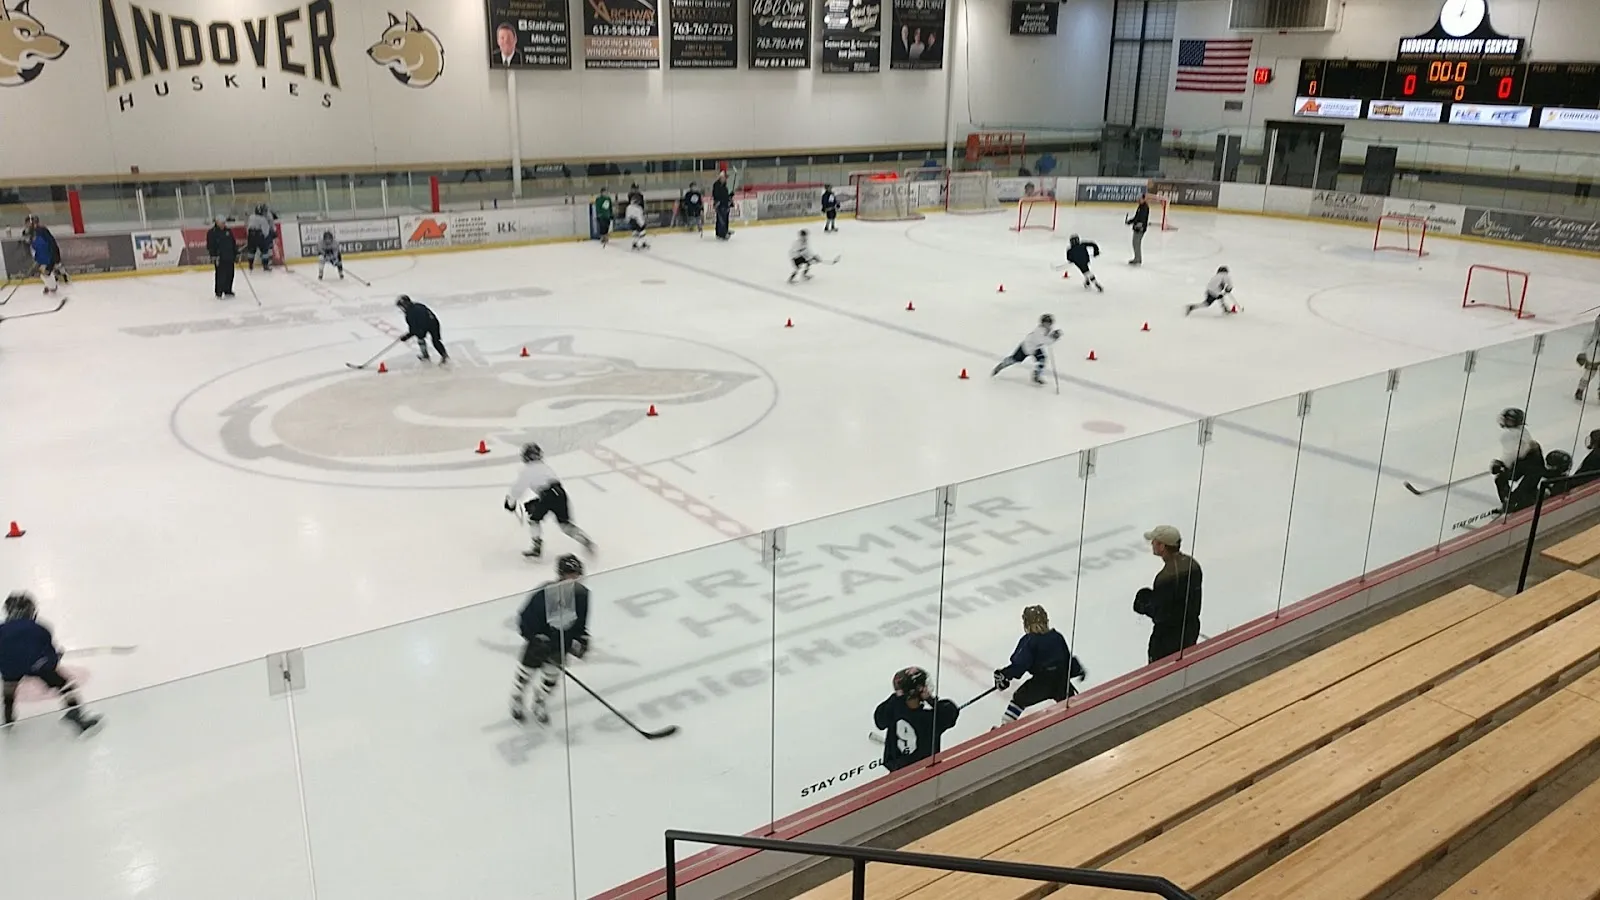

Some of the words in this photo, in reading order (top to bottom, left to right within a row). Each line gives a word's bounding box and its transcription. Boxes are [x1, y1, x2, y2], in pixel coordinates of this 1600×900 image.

[102, 0, 341, 91] ANDOVER
[531, 33, 550, 44] Mike
[591, 38, 623, 47] ROOFING
[629, 38, 652, 47] SIDING
[1400, 39, 1436, 53] ANDOVER
[1436, 39, 1485, 54] COMMUNITY
[1485, 39, 1519, 54] CENTER
[586, 48, 622, 57] WINDOWS
[628, 48, 658, 57] GUTTERS
[1429, 61, 1468, 82] 00.0
[118, 74, 333, 112] HUSKIES
[1404, 74, 1417, 95] 0
[1454, 84, 1465, 101] 0
[1498, 77, 1513, 98] 0
[497, 222, 517, 233] RK
[1468, 514, 1480, 523] OFF
[613, 496, 1032, 618] PREMIER
[677, 519, 1054, 638] HEALTH
[801, 777, 835, 798] STAY
[839, 765, 865, 782] OFF
